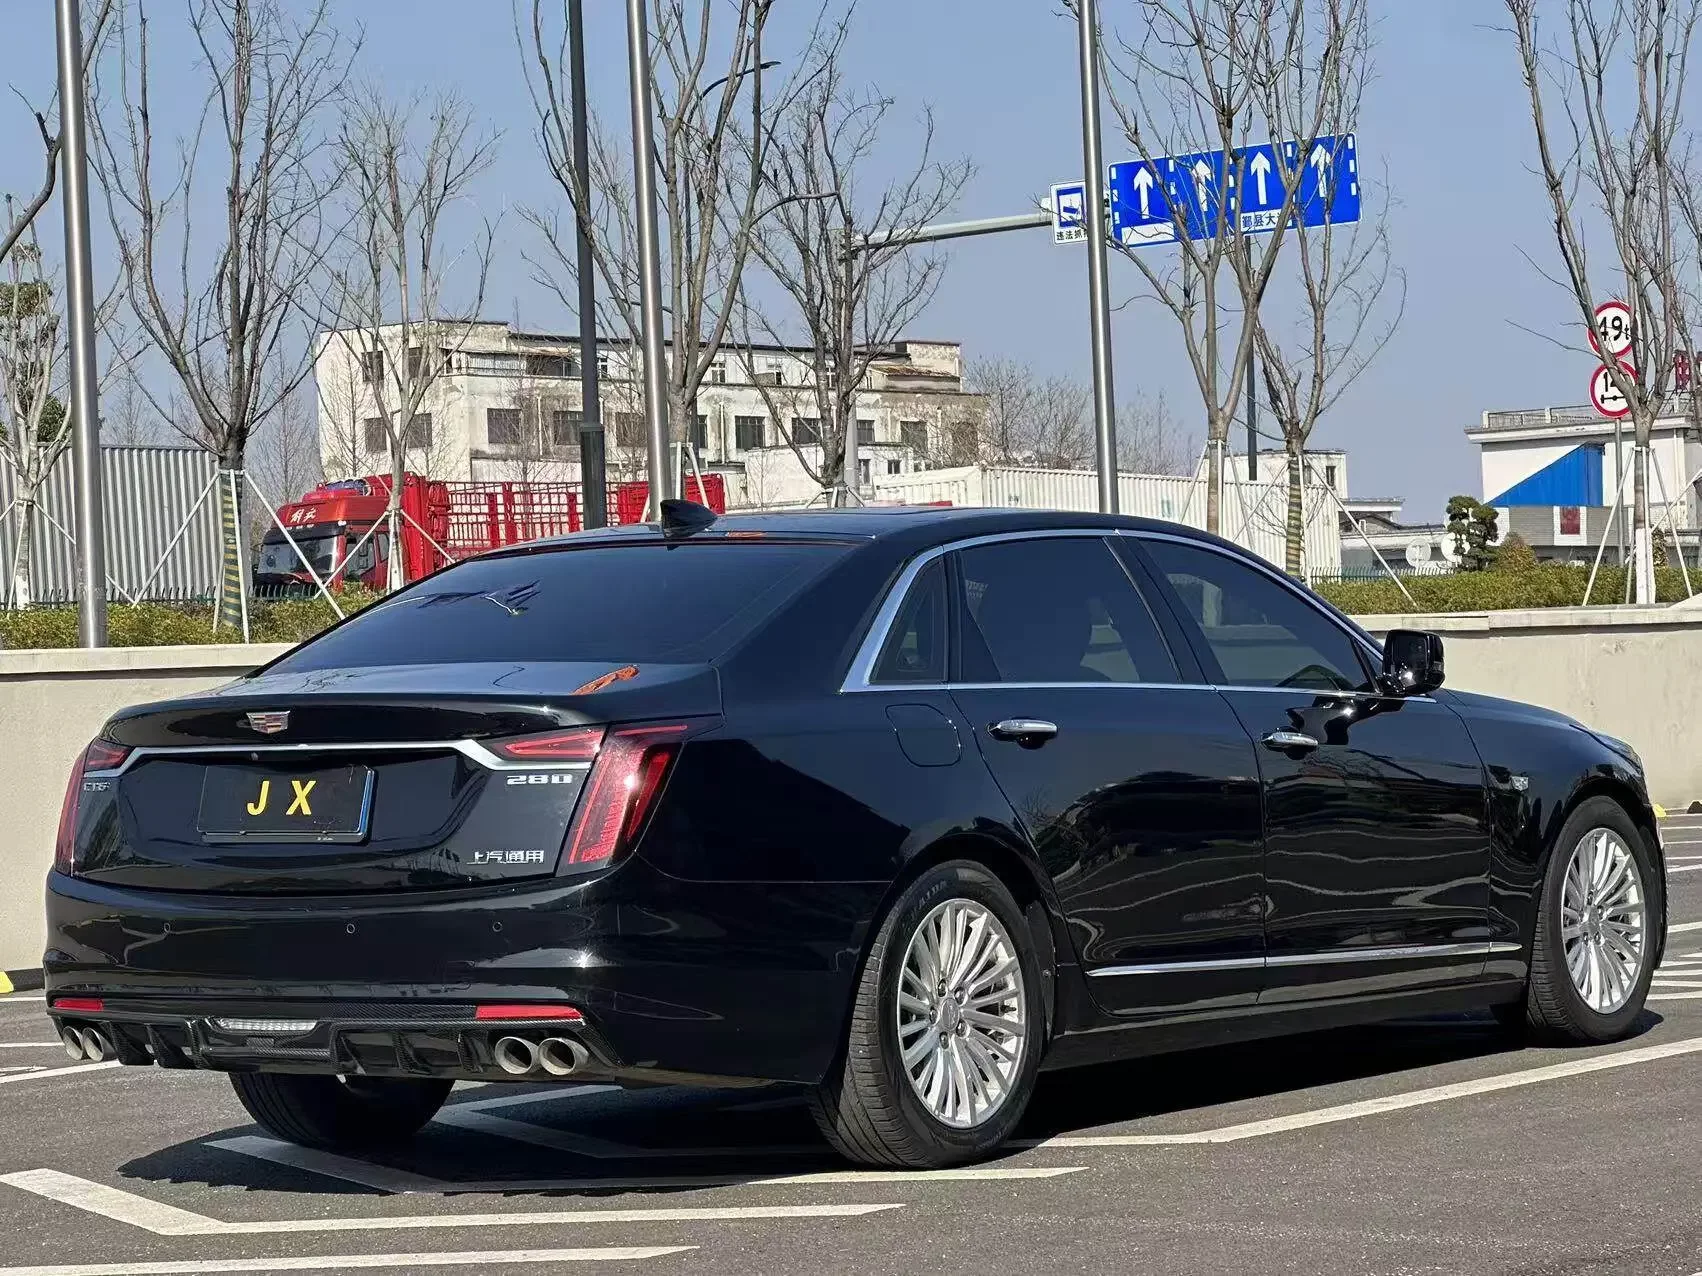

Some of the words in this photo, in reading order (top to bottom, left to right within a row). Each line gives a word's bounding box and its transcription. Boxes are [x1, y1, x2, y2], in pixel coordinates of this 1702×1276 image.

[506, 774, 573, 785] 280
[466, 850, 545, 865] 上汽通用
